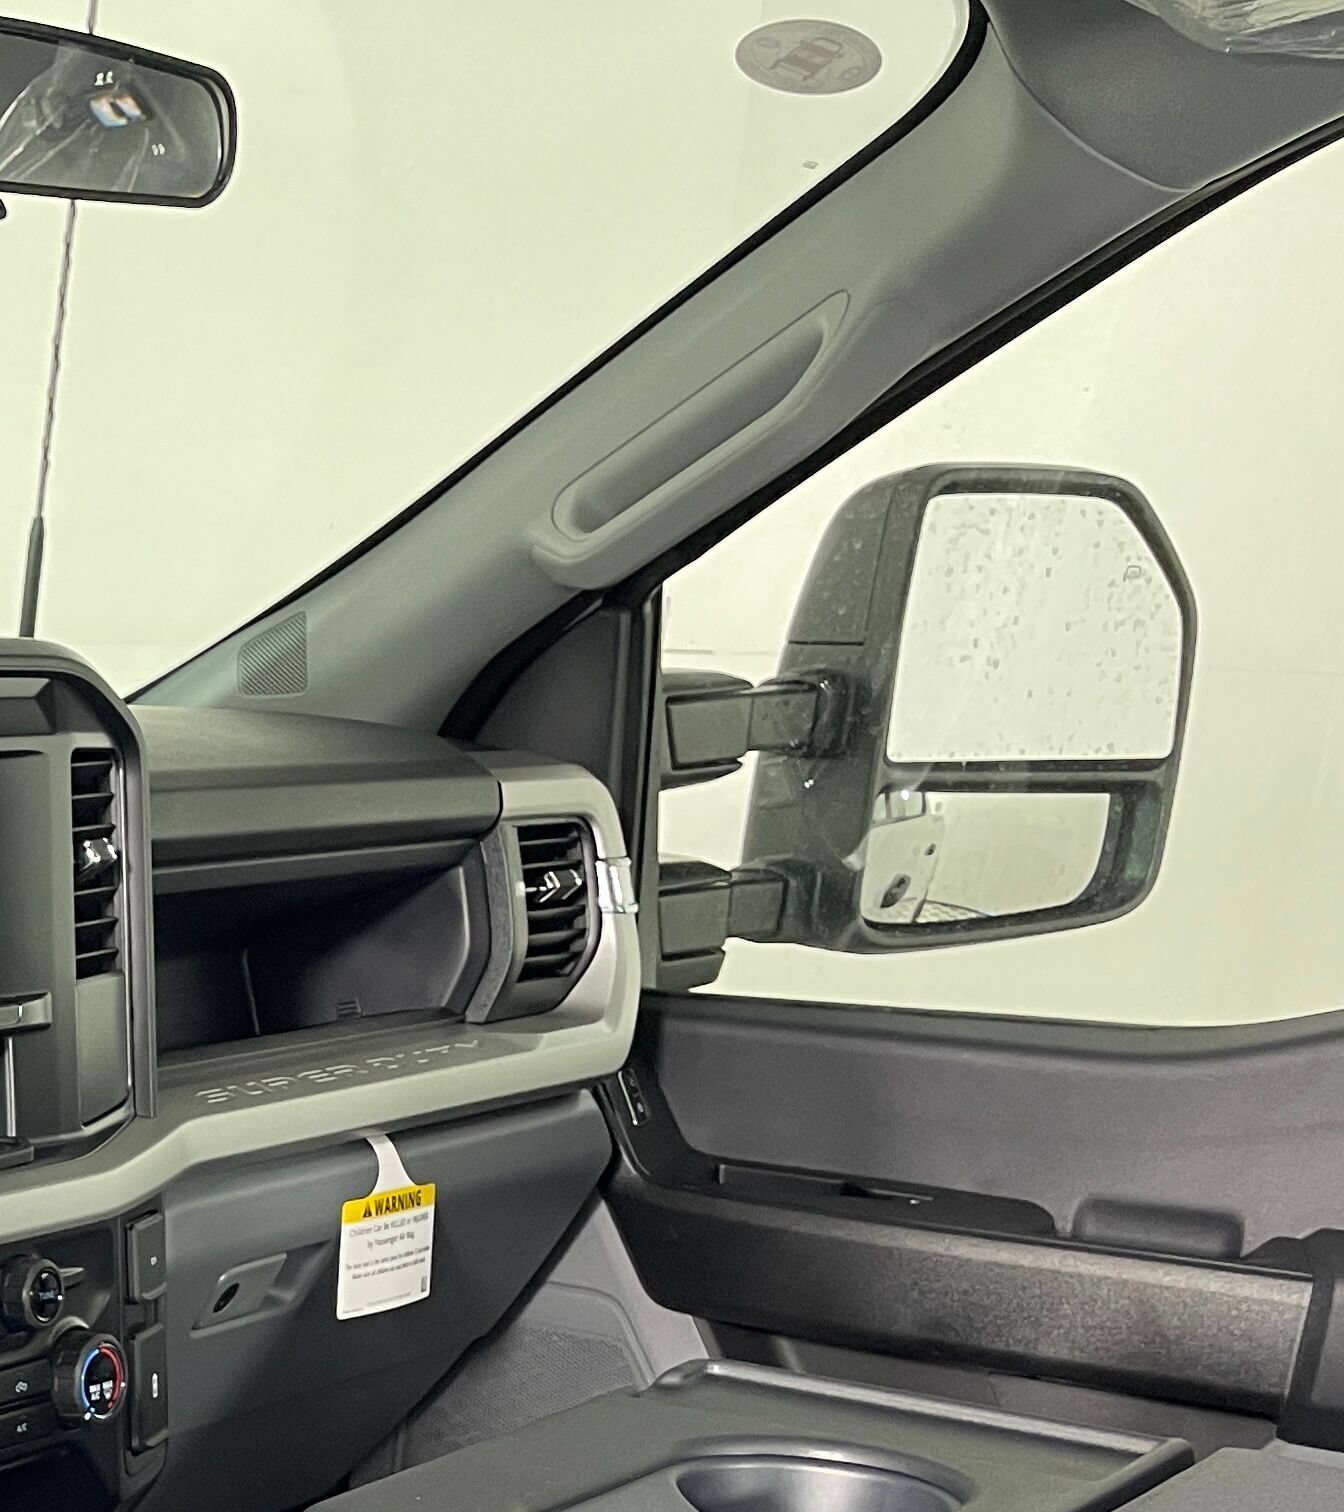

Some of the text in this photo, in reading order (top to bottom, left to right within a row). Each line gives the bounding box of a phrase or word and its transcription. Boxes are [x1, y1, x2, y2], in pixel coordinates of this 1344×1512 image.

[195, 1040, 479, 1103] SUPER DUTY
[374, 1189, 422, 1217] WARNING
